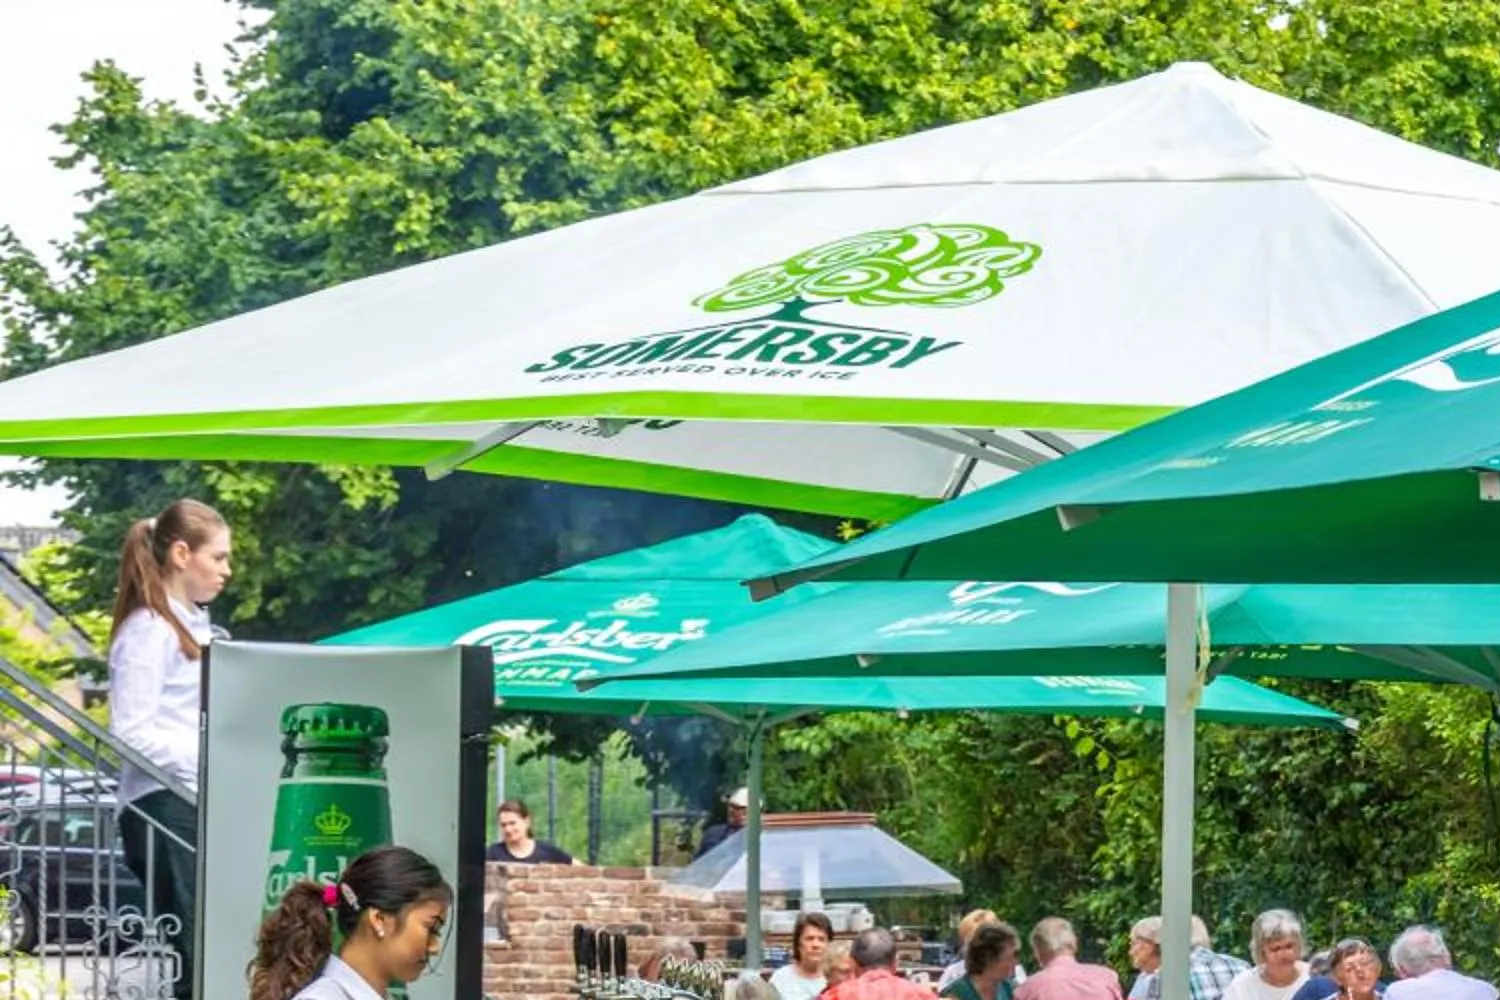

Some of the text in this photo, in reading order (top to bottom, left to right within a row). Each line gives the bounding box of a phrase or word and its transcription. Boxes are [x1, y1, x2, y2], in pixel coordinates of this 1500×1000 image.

[525, 323, 966, 374] SOMERSBY
[609, 364, 715, 379] SERVED
[724, 366, 804, 379] OVER
[809, 370, 859, 381] ICE
